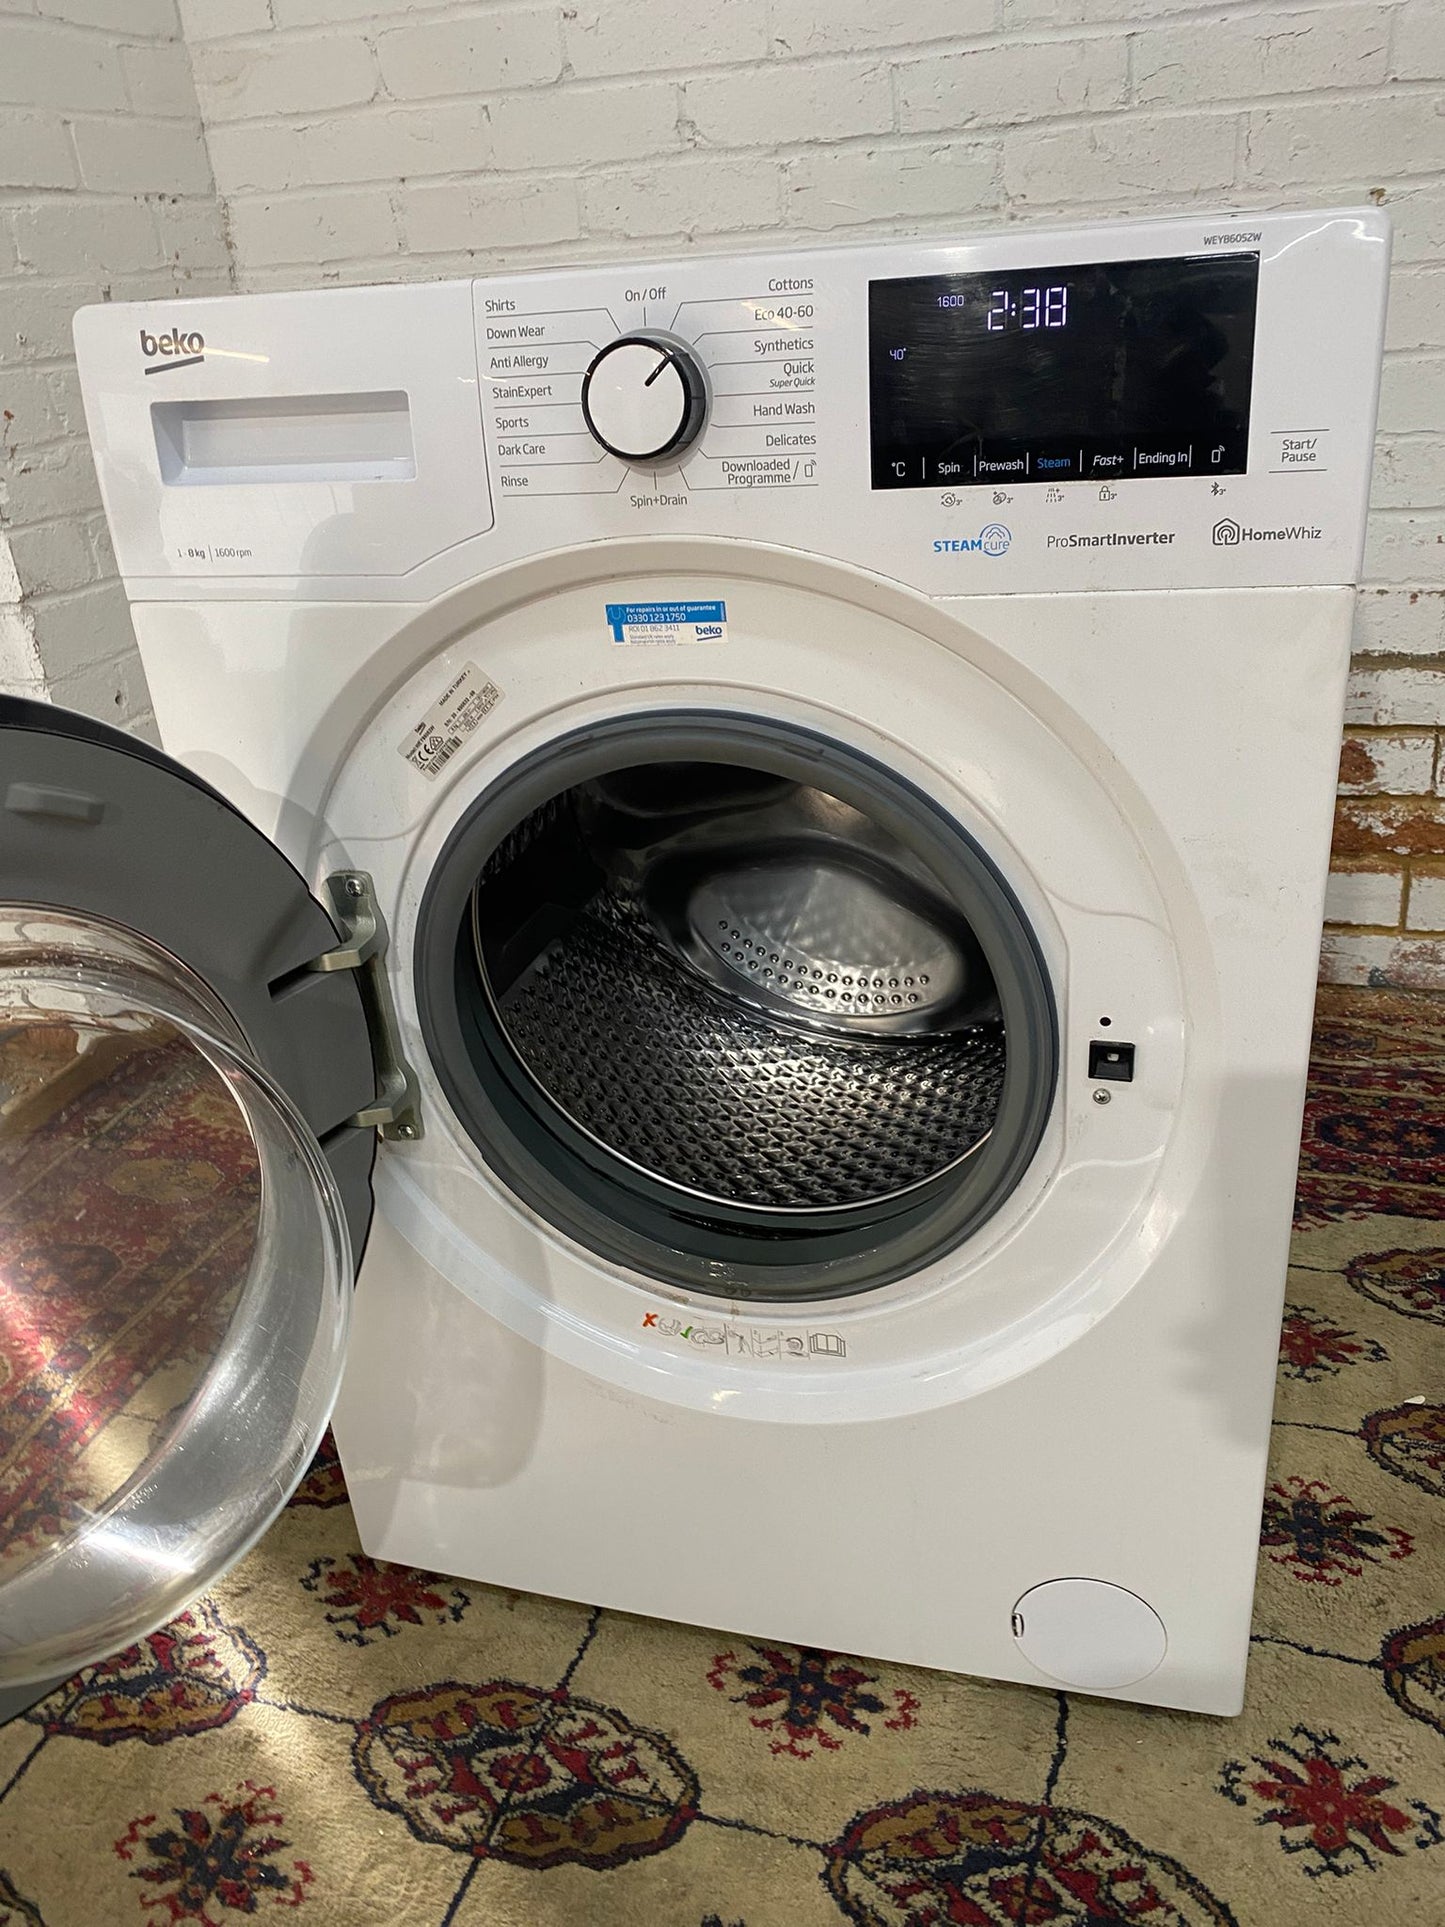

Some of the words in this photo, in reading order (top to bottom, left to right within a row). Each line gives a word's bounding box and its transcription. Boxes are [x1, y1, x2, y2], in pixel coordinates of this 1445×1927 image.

[1204, 231, 1263, 245] WEYB6052W
[768, 278, 814, 291] Cottons
[625, 290, 640, 301] On
[649, 286, 667, 300] Off
[485, 299, 516, 312] Shirts
[937, 295, 965, 308] 1600
[755, 308, 775, 320] Eco
[777, 304, 814, 319] 40-60
[988, 287, 1067, 331] 2:38
[486, 327, 517, 339] Down
[518, 325, 545, 337] Wear
[140, 328, 204, 356] beko
[754, 337, 814, 355] Synthetics
[490, 356, 512, 369] Anti
[513, 354, 549, 369] Allergy
[783, 360, 815, 377] Quick
[769, 378, 793, 389] Super
[793, 377, 816, 388] Quick
[492, 385, 552, 399] StainExpert
[753, 403, 783, 416] Hand
[784, 402, 815, 415] Wash
[495, 417, 529, 431] Sports
[765, 433, 817, 447] Delicates
[1282, 438, 1318, 451] Start/
[498, 444, 522, 456] Dark
[522, 443, 546, 454] Care
[1037, 457, 1071, 469] Steam
[1093, 454, 1124, 466] Fast+
[1139, 452, 1176, 466] Ending
[1177, 451, 1188, 463] In
[1281, 451, 1317, 463] Pause
[722, 458, 790, 472] Downloaded
[891, 461, 906, 477] °C
[938, 461, 960, 475] Spin
[979, 459, 1024, 472] Prewash
[501, 475, 529, 487] Rinse
[728, 472, 791, 488] Programme
[630, 493, 688, 509] Spin+Drain
[1047, 532, 1175, 548] ProSmartInverter
[1242, 526, 1322, 541] HomeWhiz
[636, 606, 655, 614] repairs
[686, 604, 716, 612] guarantee
[627, 614, 648, 622] 0330
[649, 613, 665, 622] 123
[665, 612, 686, 621] 1750
[695, 625, 722, 635] beko
